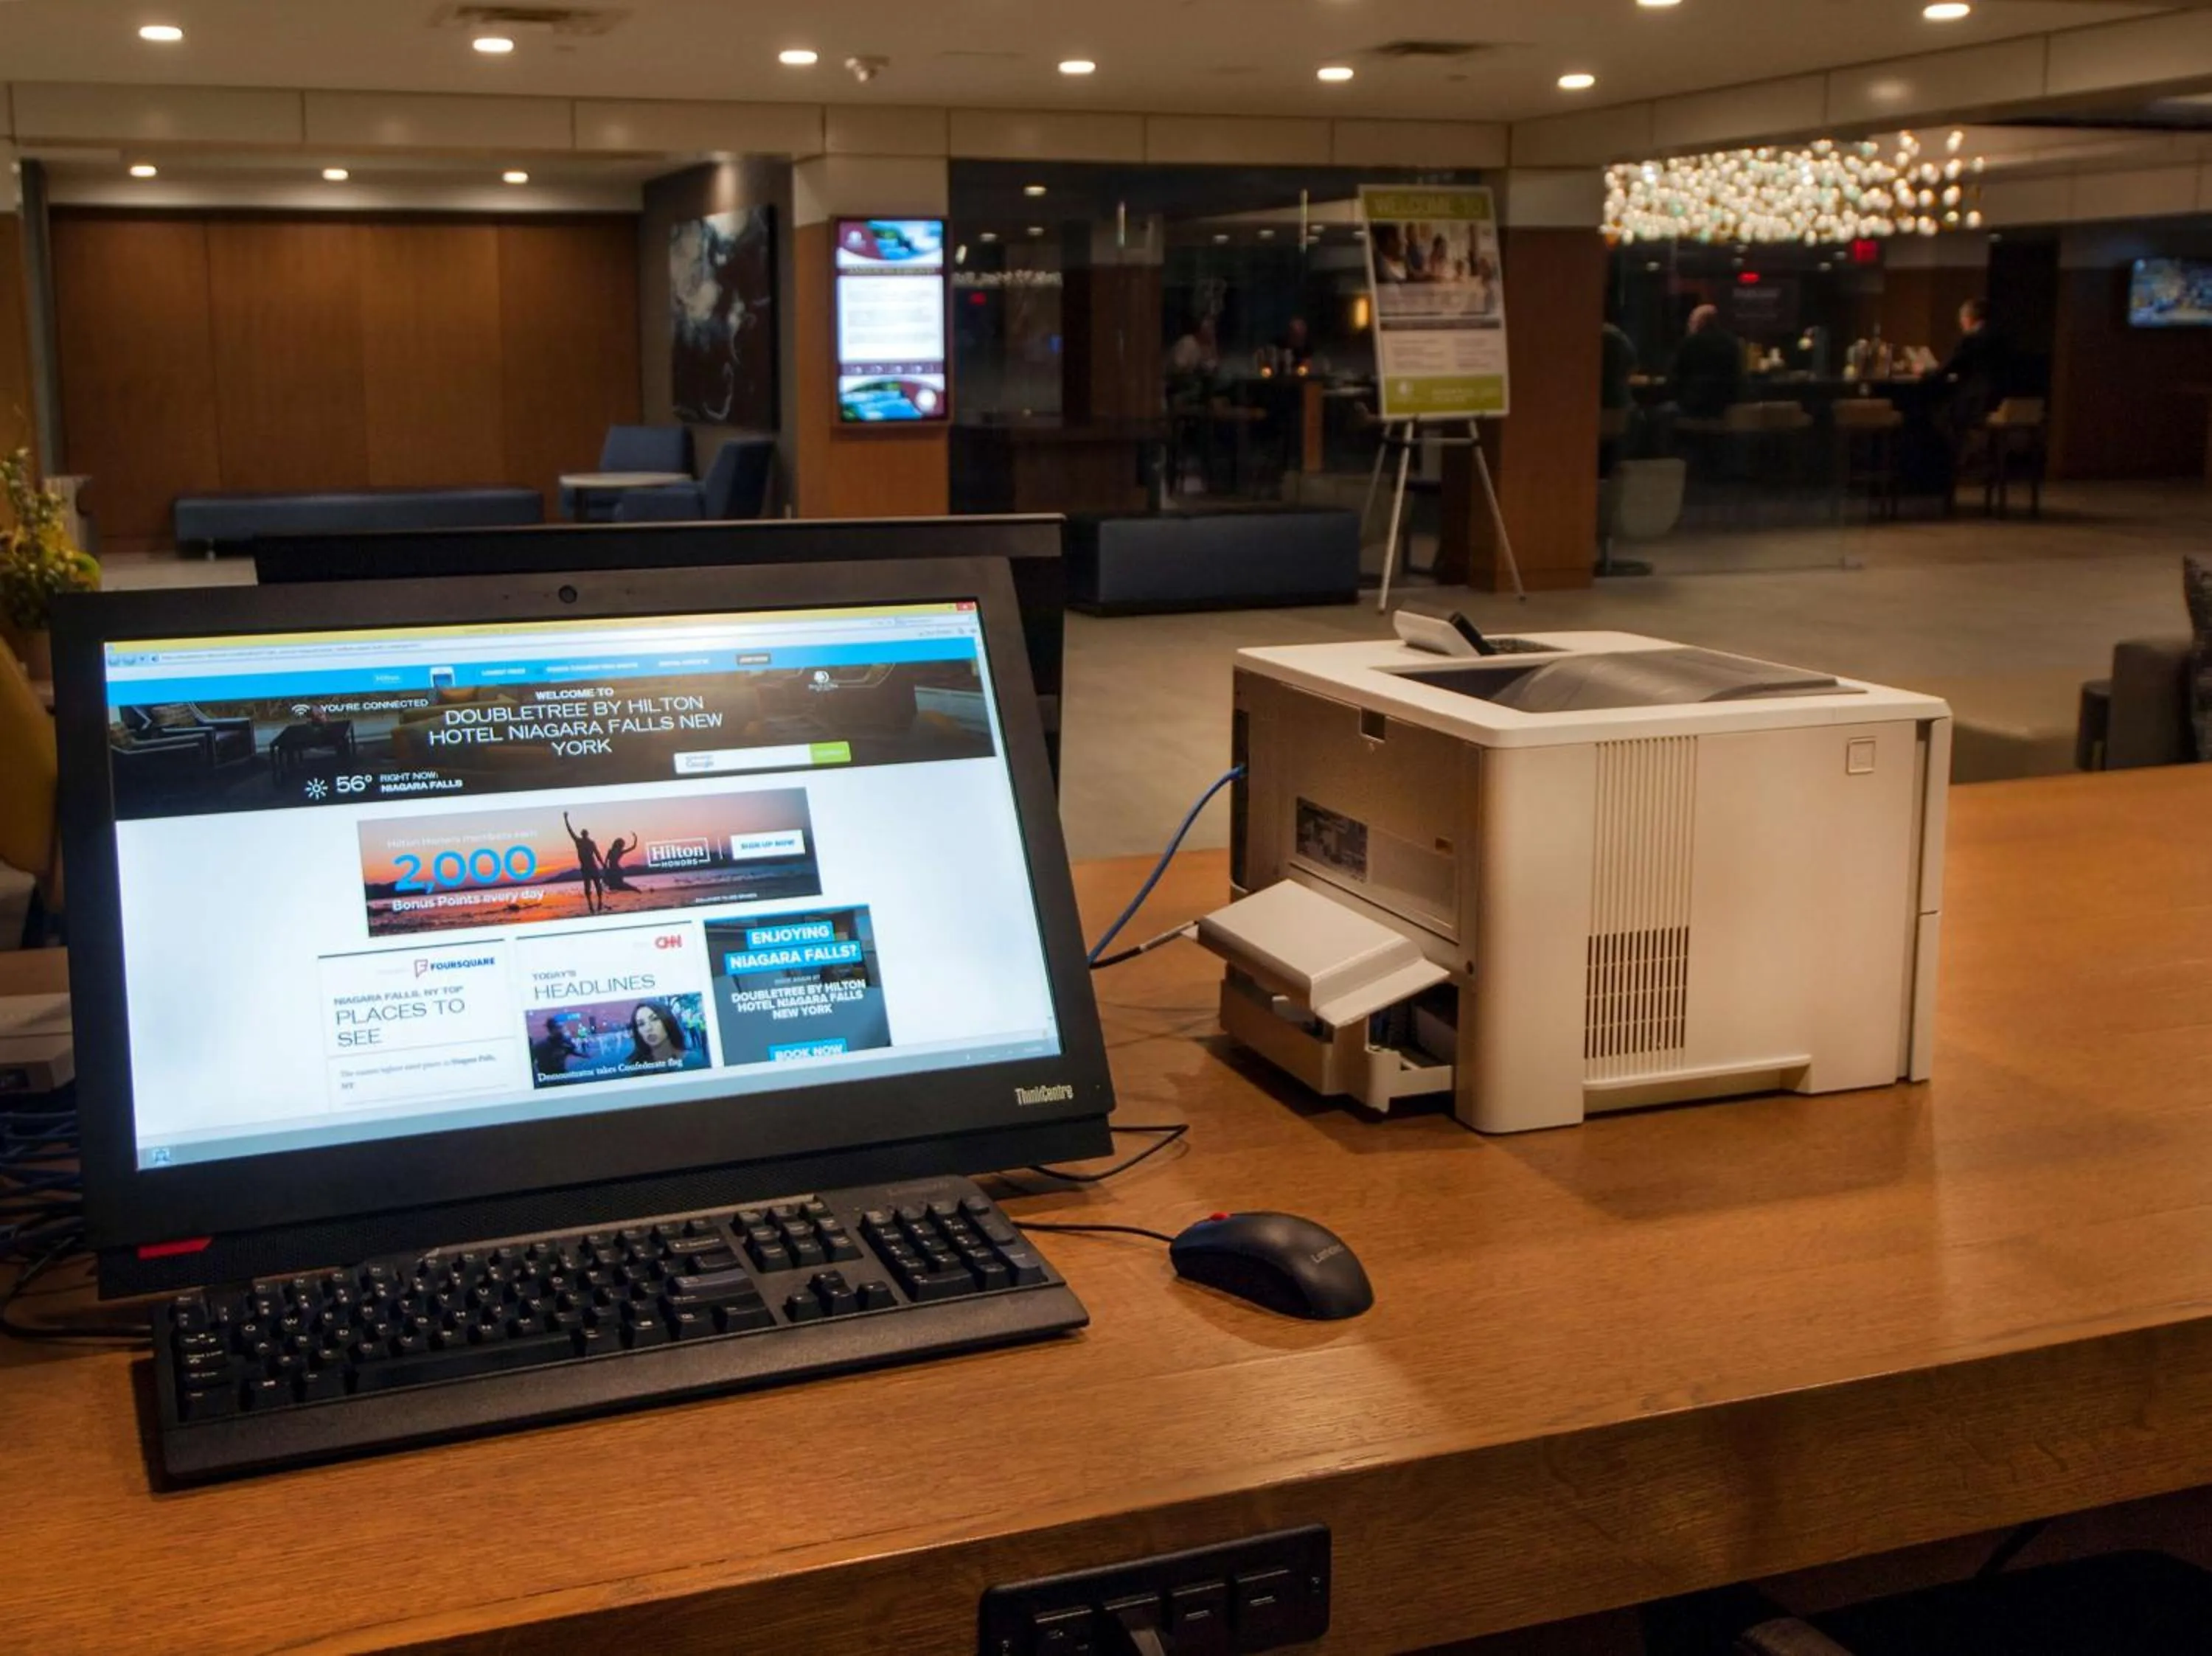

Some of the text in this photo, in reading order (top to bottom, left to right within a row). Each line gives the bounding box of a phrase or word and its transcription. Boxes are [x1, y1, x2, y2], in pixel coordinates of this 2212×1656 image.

[535, 687, 613, 700] WELCOME TO
[321, 698, 428, 712] YOU'RE CONNECTED
[445, 695, 704, 725] DOUBLETREE BY HILTON
[429, 712, 723, 745] HOTEL NIAGARA FALLS NEW
[552, 738, 613, 756] YORK
[380, 773, 409, 782] RIGHT
[381, 779, 463, 793] NIAGARA FALLS
[651, 844, 704, 860] Hilton
[392, 844, 538, 894] 2,000
[661, 858, 698, 867] HONORS
[392, 888, 545, 911] Bonus Points every day
[655, 935, 682, 950] CNN
[751, 925, 830, 944] ENJOYING
[430, 957, 495, 971] FOURSQUARE
[730, 944, 857, 968] NIAGARA FALLS?
[532, 970, 577, 981] TODAY'S
[334, 993, 382, 1005] NIAGARA
[424, 988, 439, 996] NY
[443, 986, 463, 994] TOP
[534, 974, 655, 1001] HEADLINES
[731, 985, 806, 1003] DOUBLETREE
[808, 984, 823, 994] BY
[825, 979, 866, 992] HILTON
[737, 990, 864, 1012] HOTEL NIAGARA FALLS
[336, 998, 465, 1025] PLACES TO
[773, 1003, 832, 1020] NEW YORK
[338, 1029, 383, 1047] SEE
[776, 1043, 843, 1062] BOOK NOW
[1015, 1085, 1074, 1105] ThinkCentre
